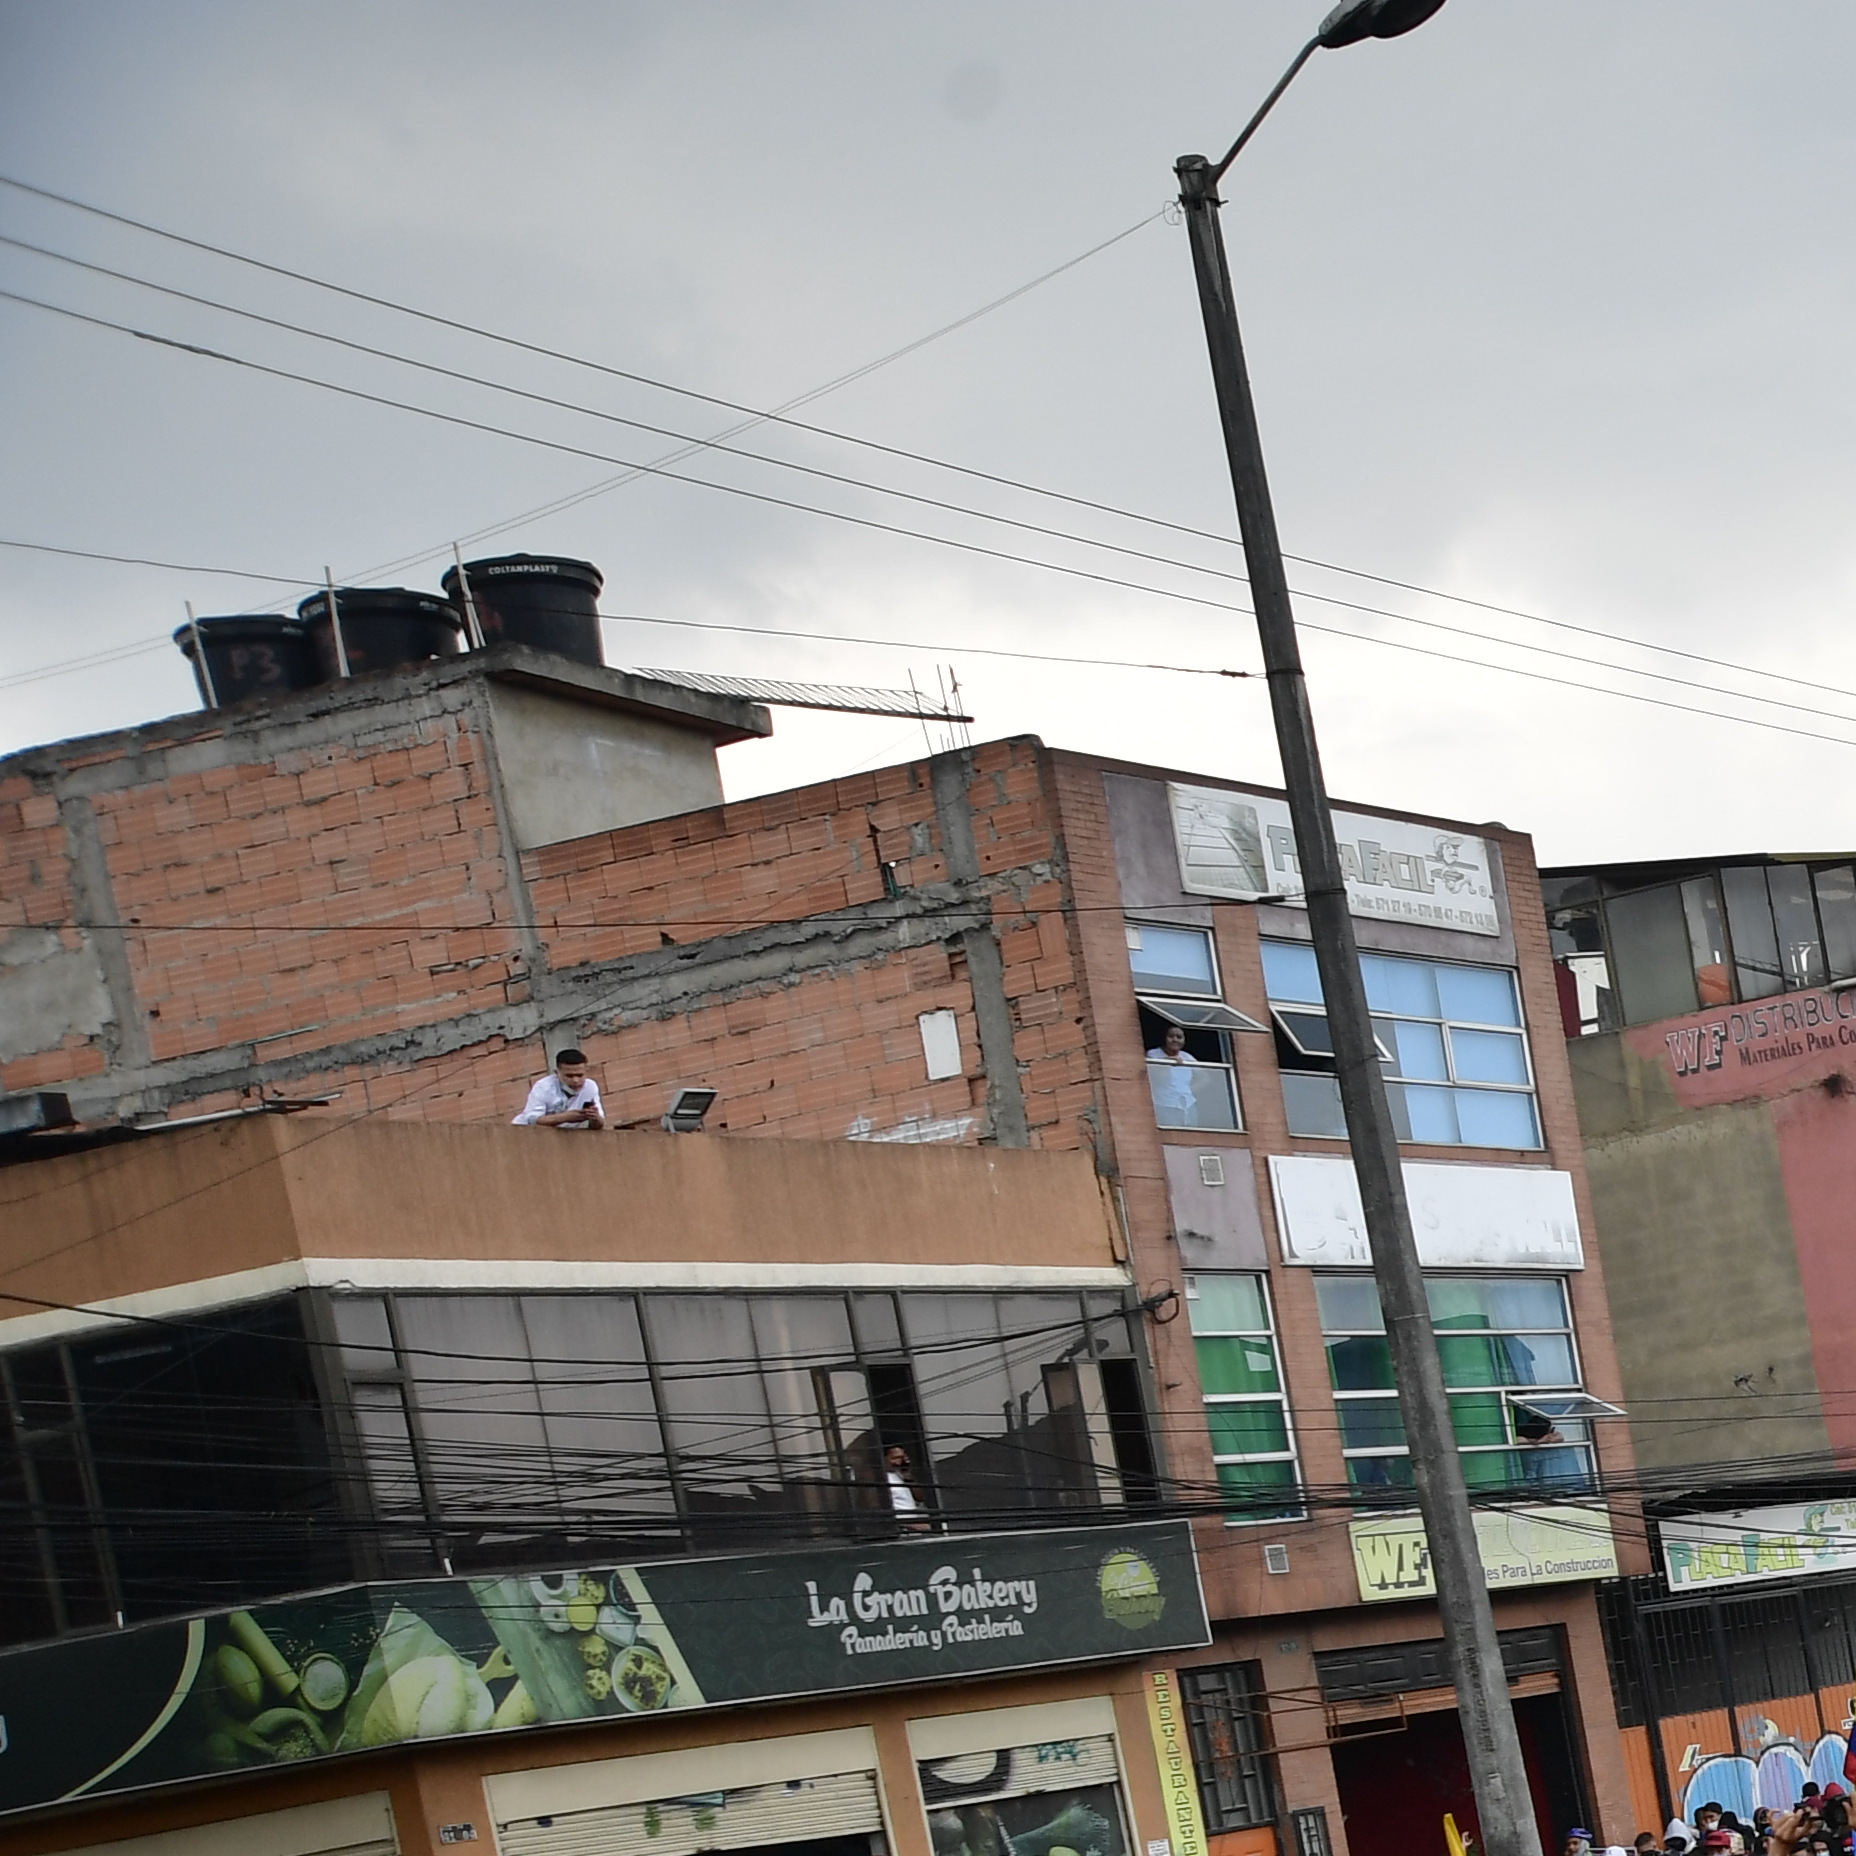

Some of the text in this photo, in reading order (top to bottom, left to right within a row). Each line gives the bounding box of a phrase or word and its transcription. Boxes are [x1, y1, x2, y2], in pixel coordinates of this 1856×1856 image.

[1665, 1021, 1728, 1077] WF
[1501, 1563, 1528, 1581] Para
[1667, 1533, 1805, 1583] PLACAFACIL
[804, 1579, 847, 1627] La
[850, 1571, 929, 1624] Gran
[929, 1564, 1038, 1615] Bakery
[840, 1613, 1025, 1656] Panadería y Pastelería
[1152, 1672, 1198, 1856] RESTAURANTE
